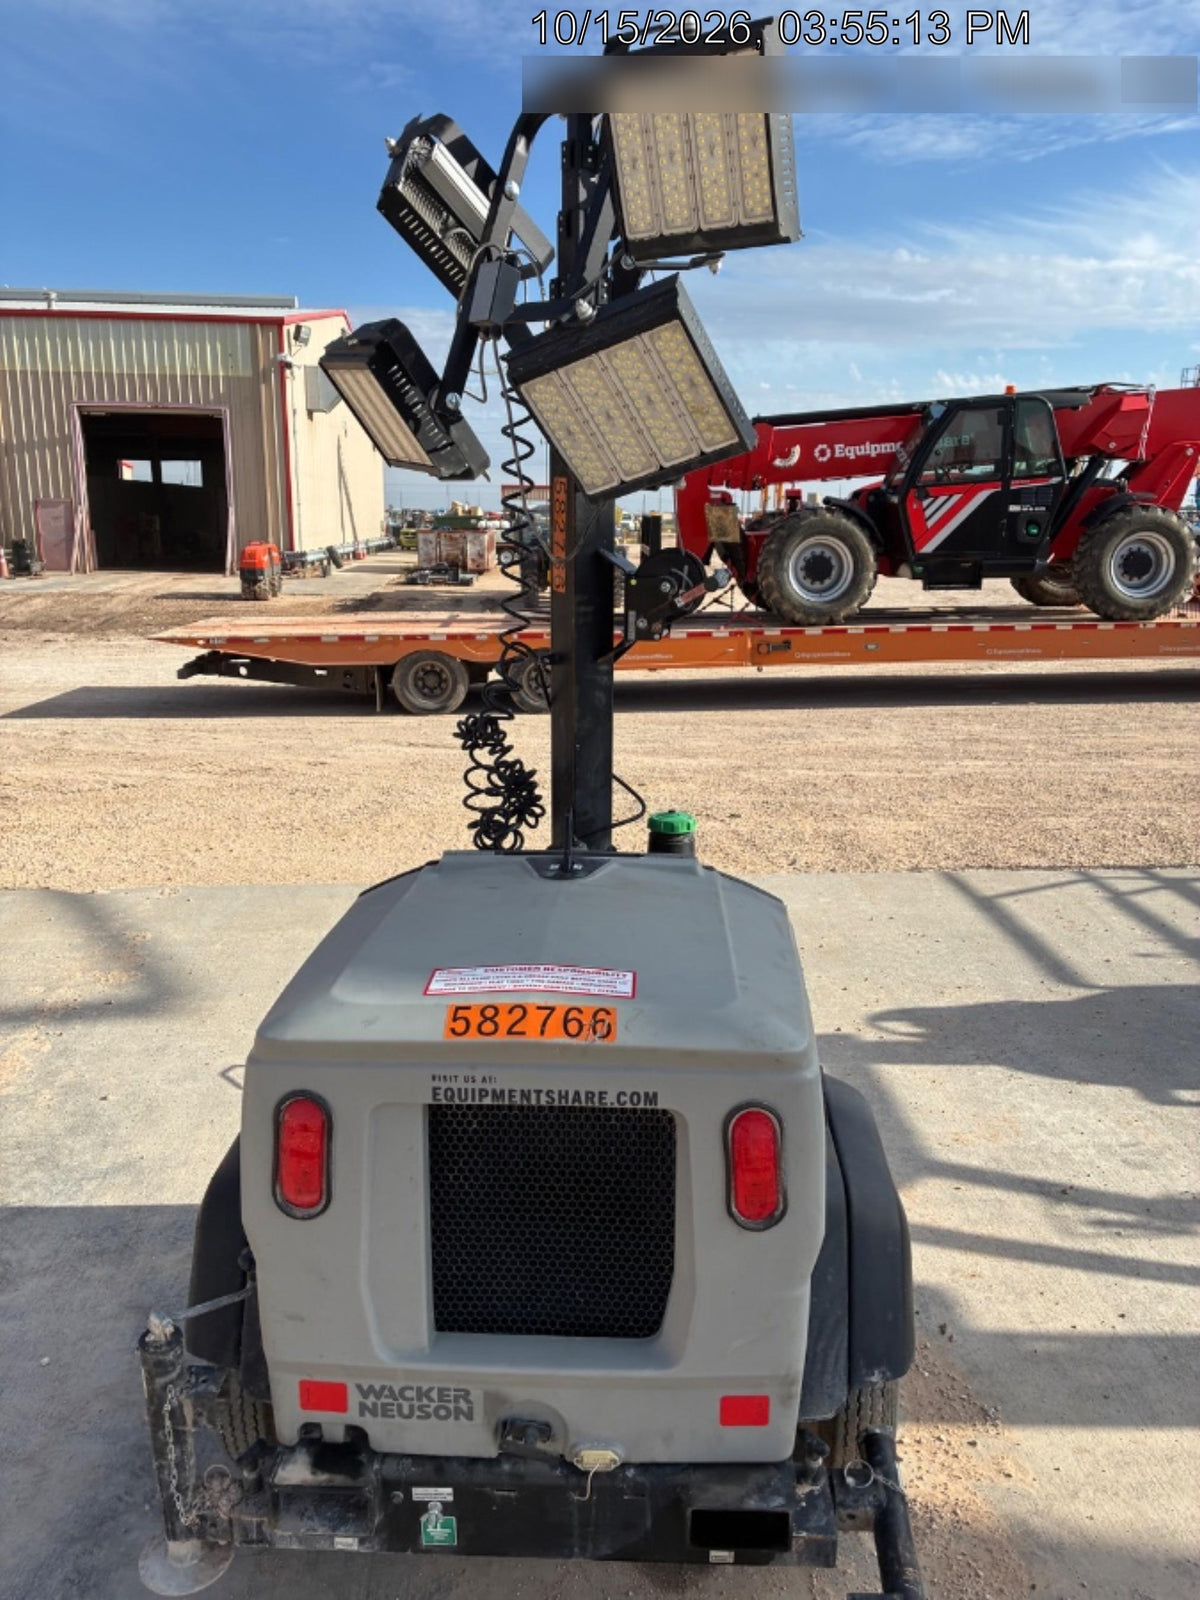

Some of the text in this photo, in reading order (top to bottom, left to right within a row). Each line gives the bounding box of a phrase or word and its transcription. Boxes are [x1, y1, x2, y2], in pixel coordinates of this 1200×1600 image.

[449, 1004, 613, 1039] 582766
[431, 1074, 497, 1084] VISIT US AT:
[431, 1086, 660, 1107] EQUIPMENTSHARE.COM
[354, 1383, 474, 1405] WACKER
[358, 1402, 474, 1422] NEUSON
